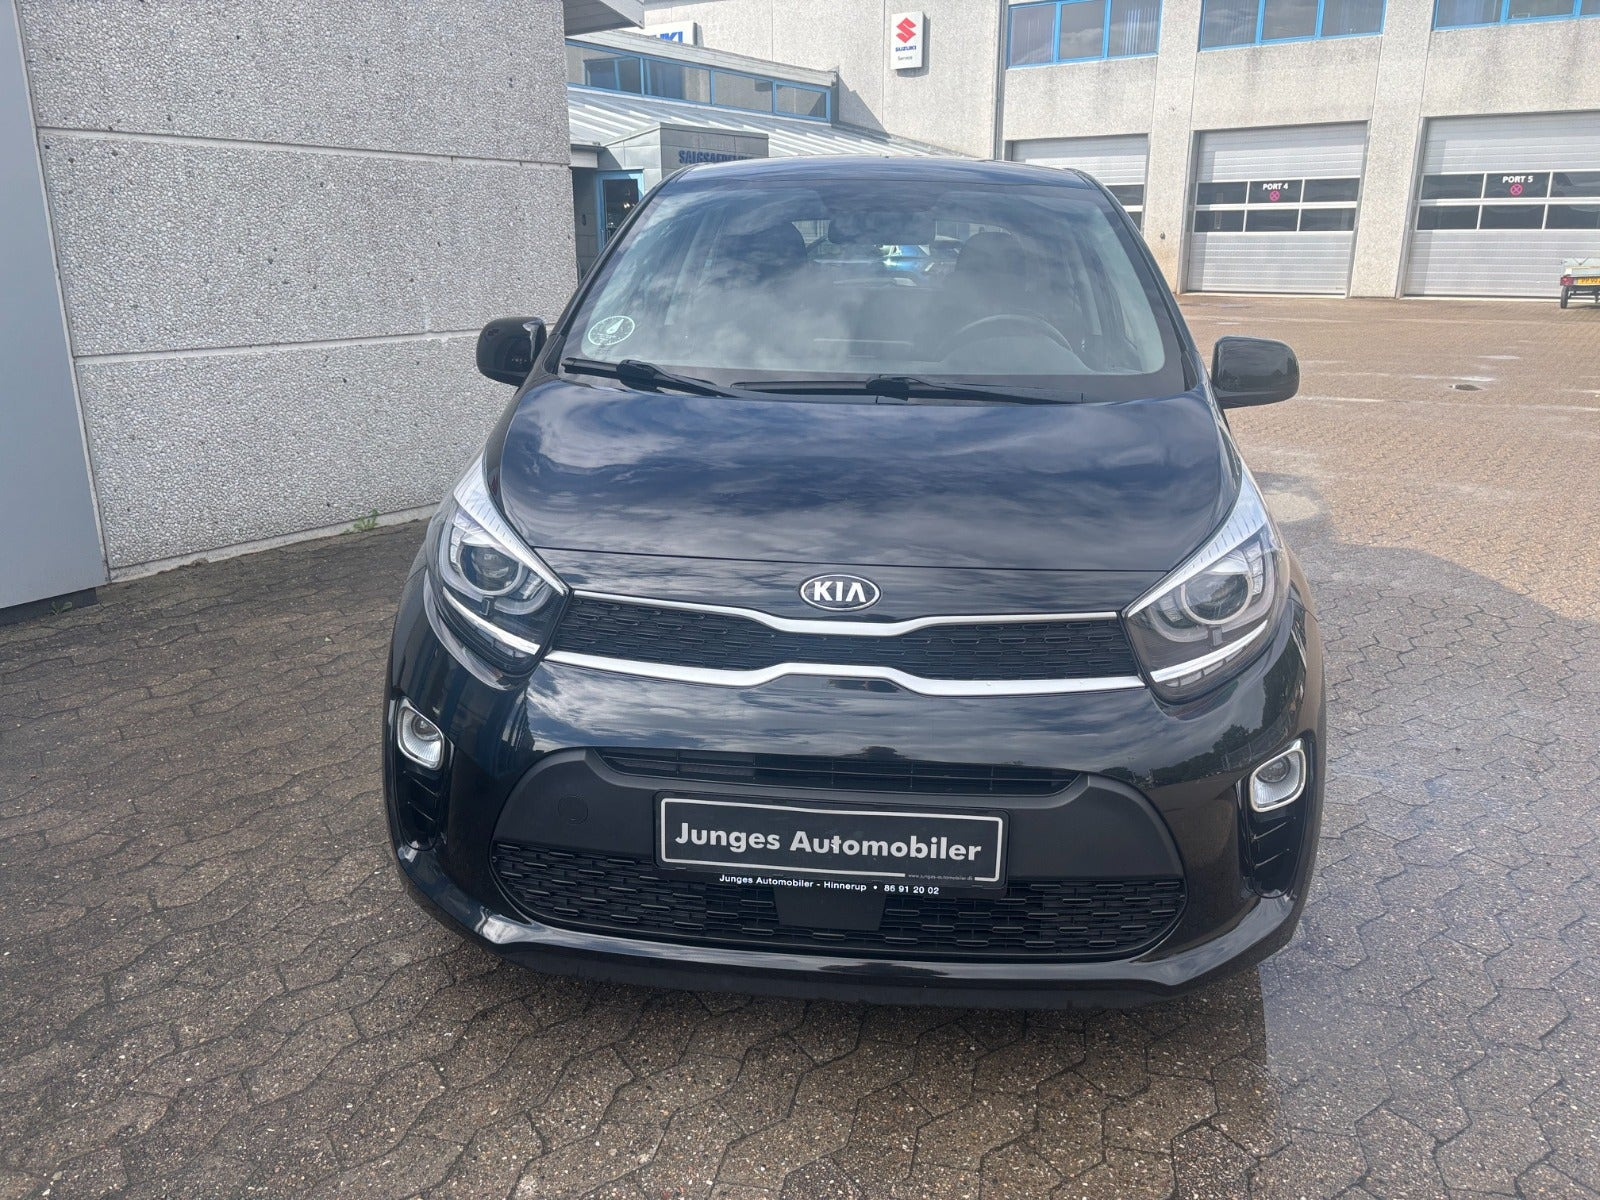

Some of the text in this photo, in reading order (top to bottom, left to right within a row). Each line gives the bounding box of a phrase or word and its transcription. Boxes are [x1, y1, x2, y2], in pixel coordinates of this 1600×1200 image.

[1283, 182, 1289, 190] 4
[1503, 175, 1534, 183] PORT 5
[813, 581, 867, 602] KIA
[675, 822, 982, 861] Junges Automobiler
[719, 874, 754, 884] Junges
[756, 876, 814, 888] Automobiler
[823, 880, 867, 892] Hinnerup
[883, 884, 896, 892] 86
[898, 885, 909, 893] 91
[912, 885, 925, 894] 20
[927, 886, 940, 895] 02
